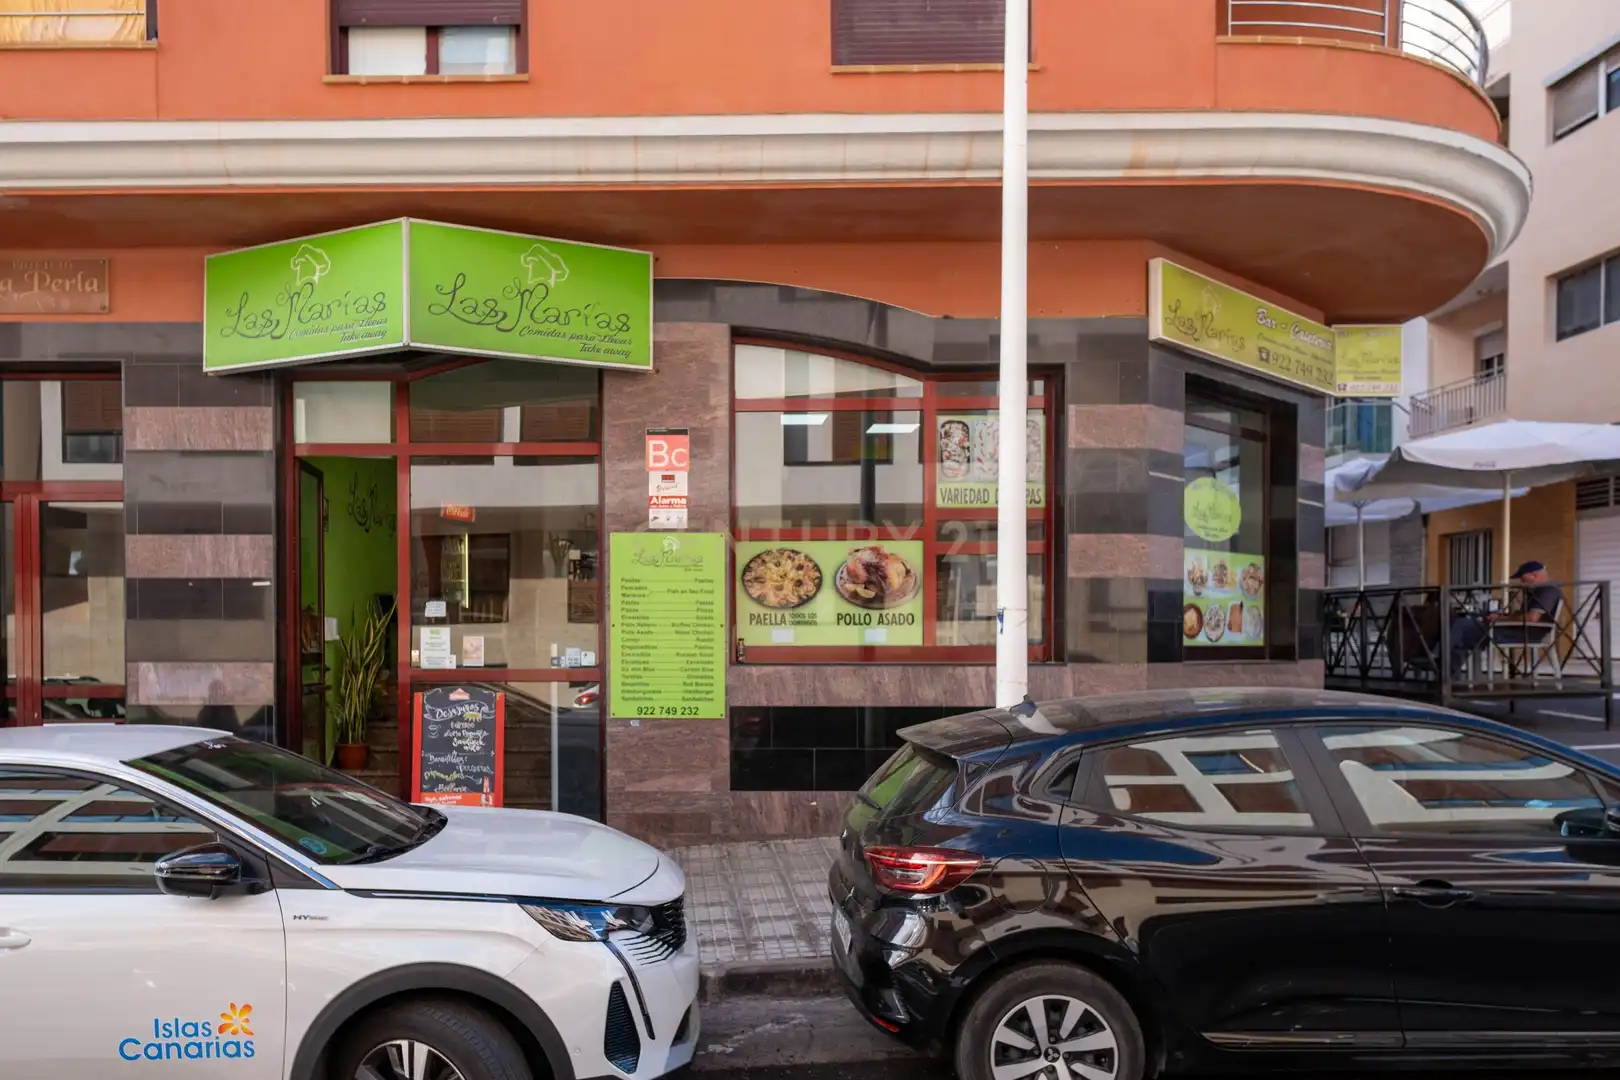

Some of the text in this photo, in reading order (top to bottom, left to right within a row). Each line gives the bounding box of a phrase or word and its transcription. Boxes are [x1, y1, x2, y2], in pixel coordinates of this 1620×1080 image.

[21, 270, 99, 298] Perla
[428, 272, 500, 326] Las
[220, 291, 274, 339] Las
[340, 329, 388, 344] Take away
[518, 326, 567, 340] Comidas
[568, 332, 596, 342] para
[579, 342, 632, 359] Take away
[1271, 353, 1292, 372] 922
[1295, 359, 1314, 377] 749
[648, 439, 688, 468] Bc
[650, 496, 687, 505] Alarma
[939, 488, 990, 505] VARIEDAD
[750, 613, 787, 625] PAELLA
[837, 613, 915, 626] POLLO ASADO
[637, 706, 699, 716] 922 749 232
[153, 1017, 212, 1039] Islas
[118, 1036, 255, 1061] Canarias
